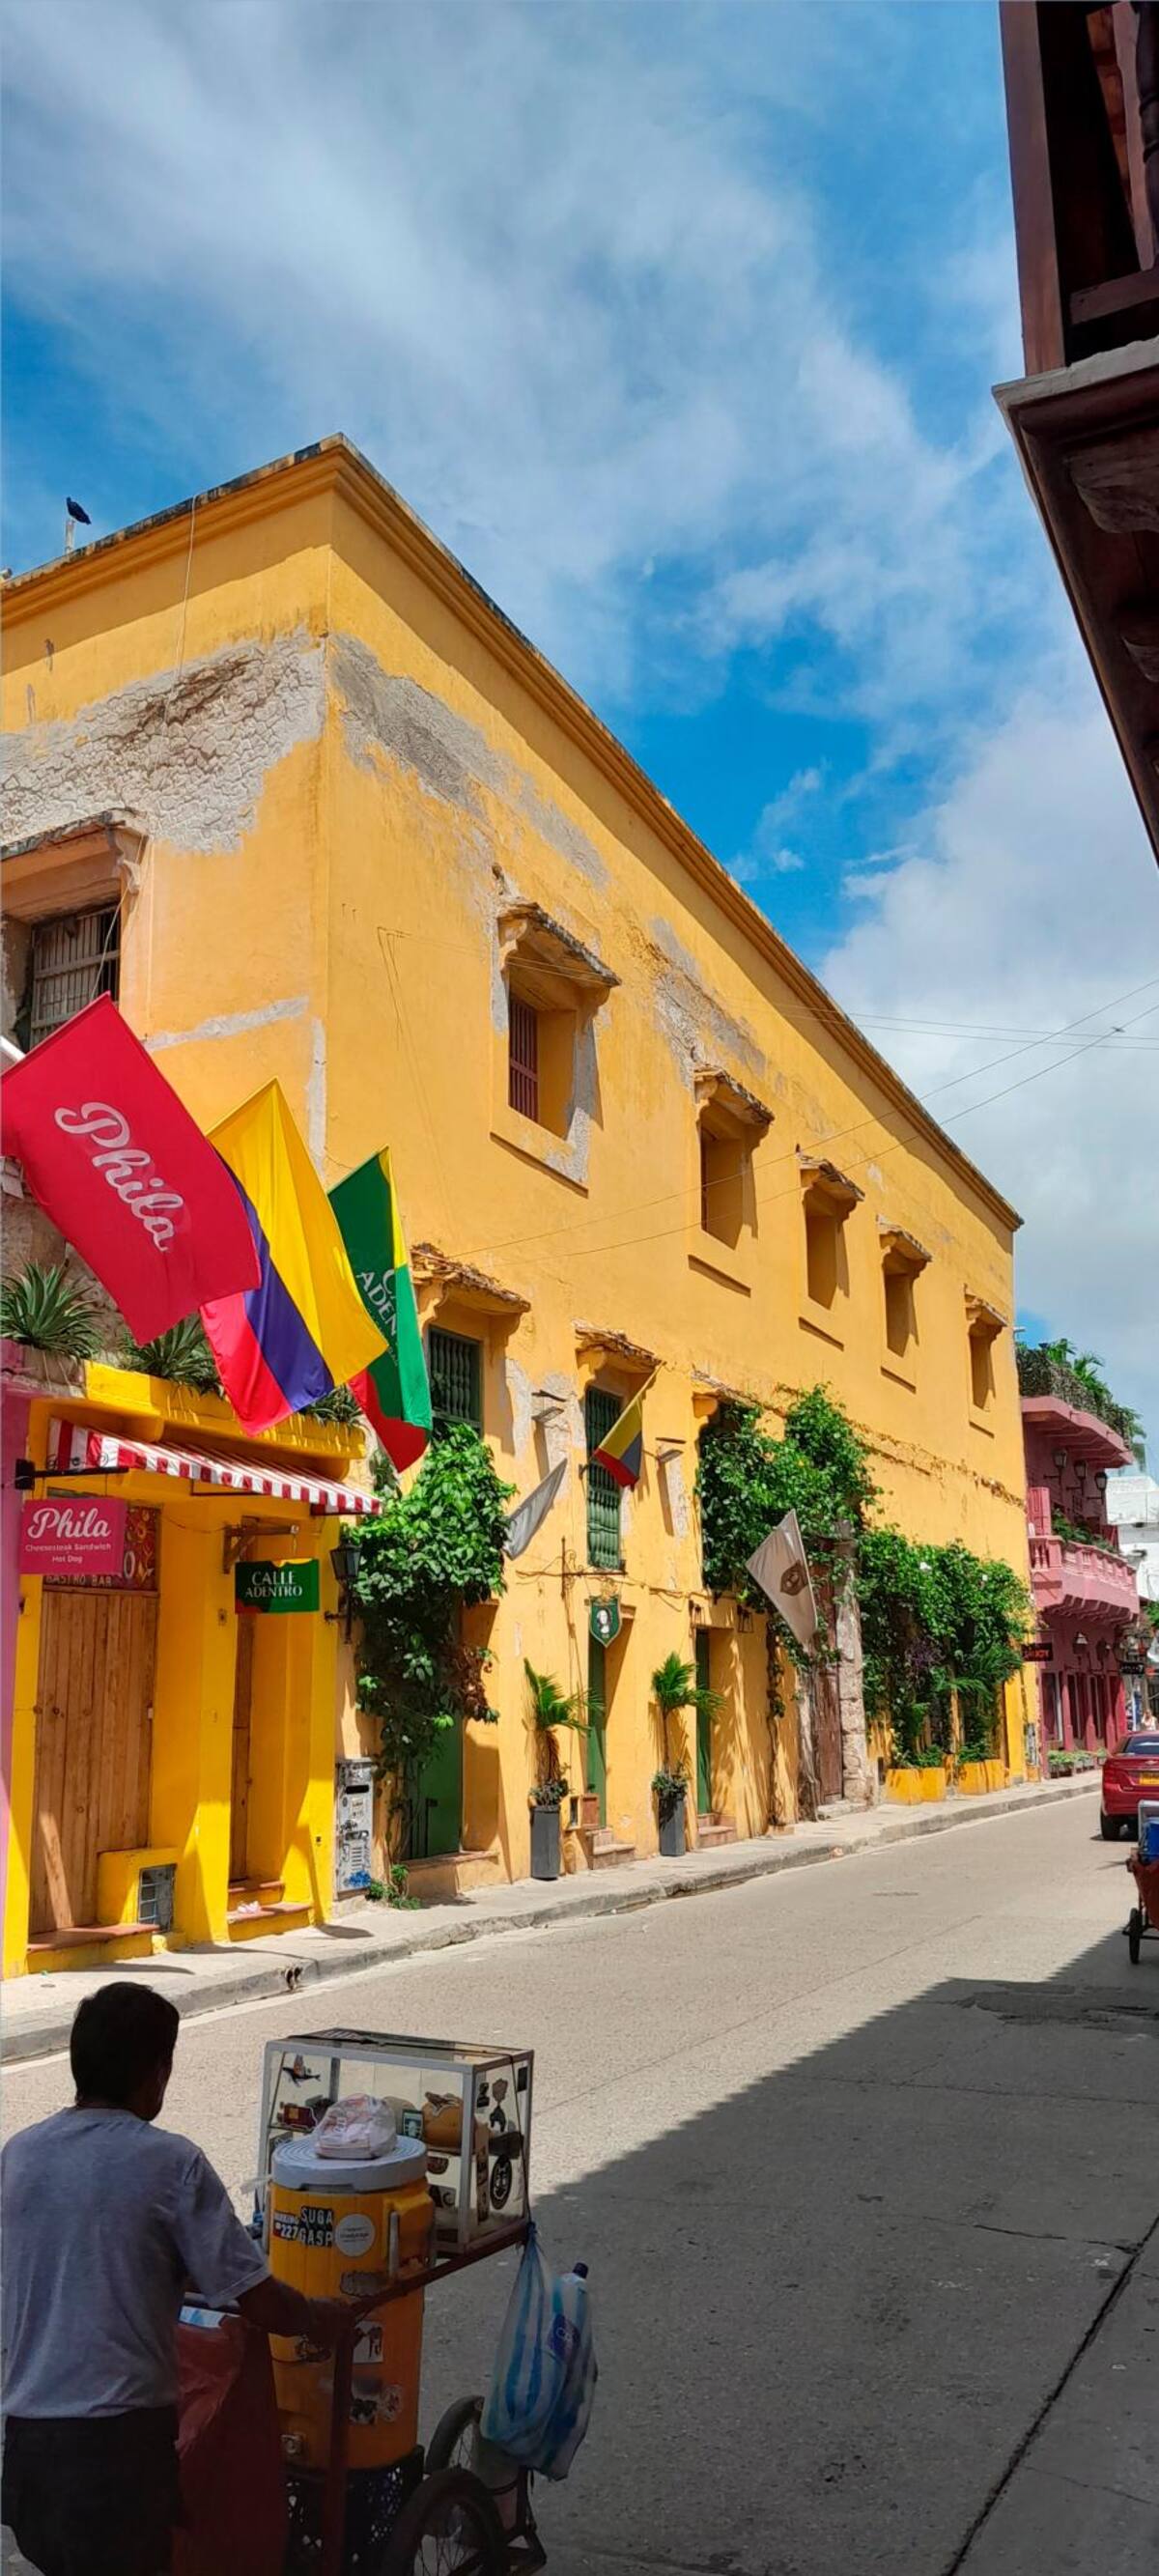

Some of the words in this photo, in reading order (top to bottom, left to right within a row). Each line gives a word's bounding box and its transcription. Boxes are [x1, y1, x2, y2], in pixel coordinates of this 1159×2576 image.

[53, 1101, 186, 1254] Phila
[355, 1270, 397, 1337] ADEN
[27, 1507, 112, 1539] Phila
[25, 1543, 72, 1552] Cheesesteak
[74, 1543, 111, 1551] Sandwich
[51, 1554, 66, 1563] Hot
[67, 1554, 83, 1564] Dog
[91, 1575, 113, 1586] BAR
[251, 1570, 296, 1585] CALLE
[245, 1585, 303, 1599] ADENTRO
